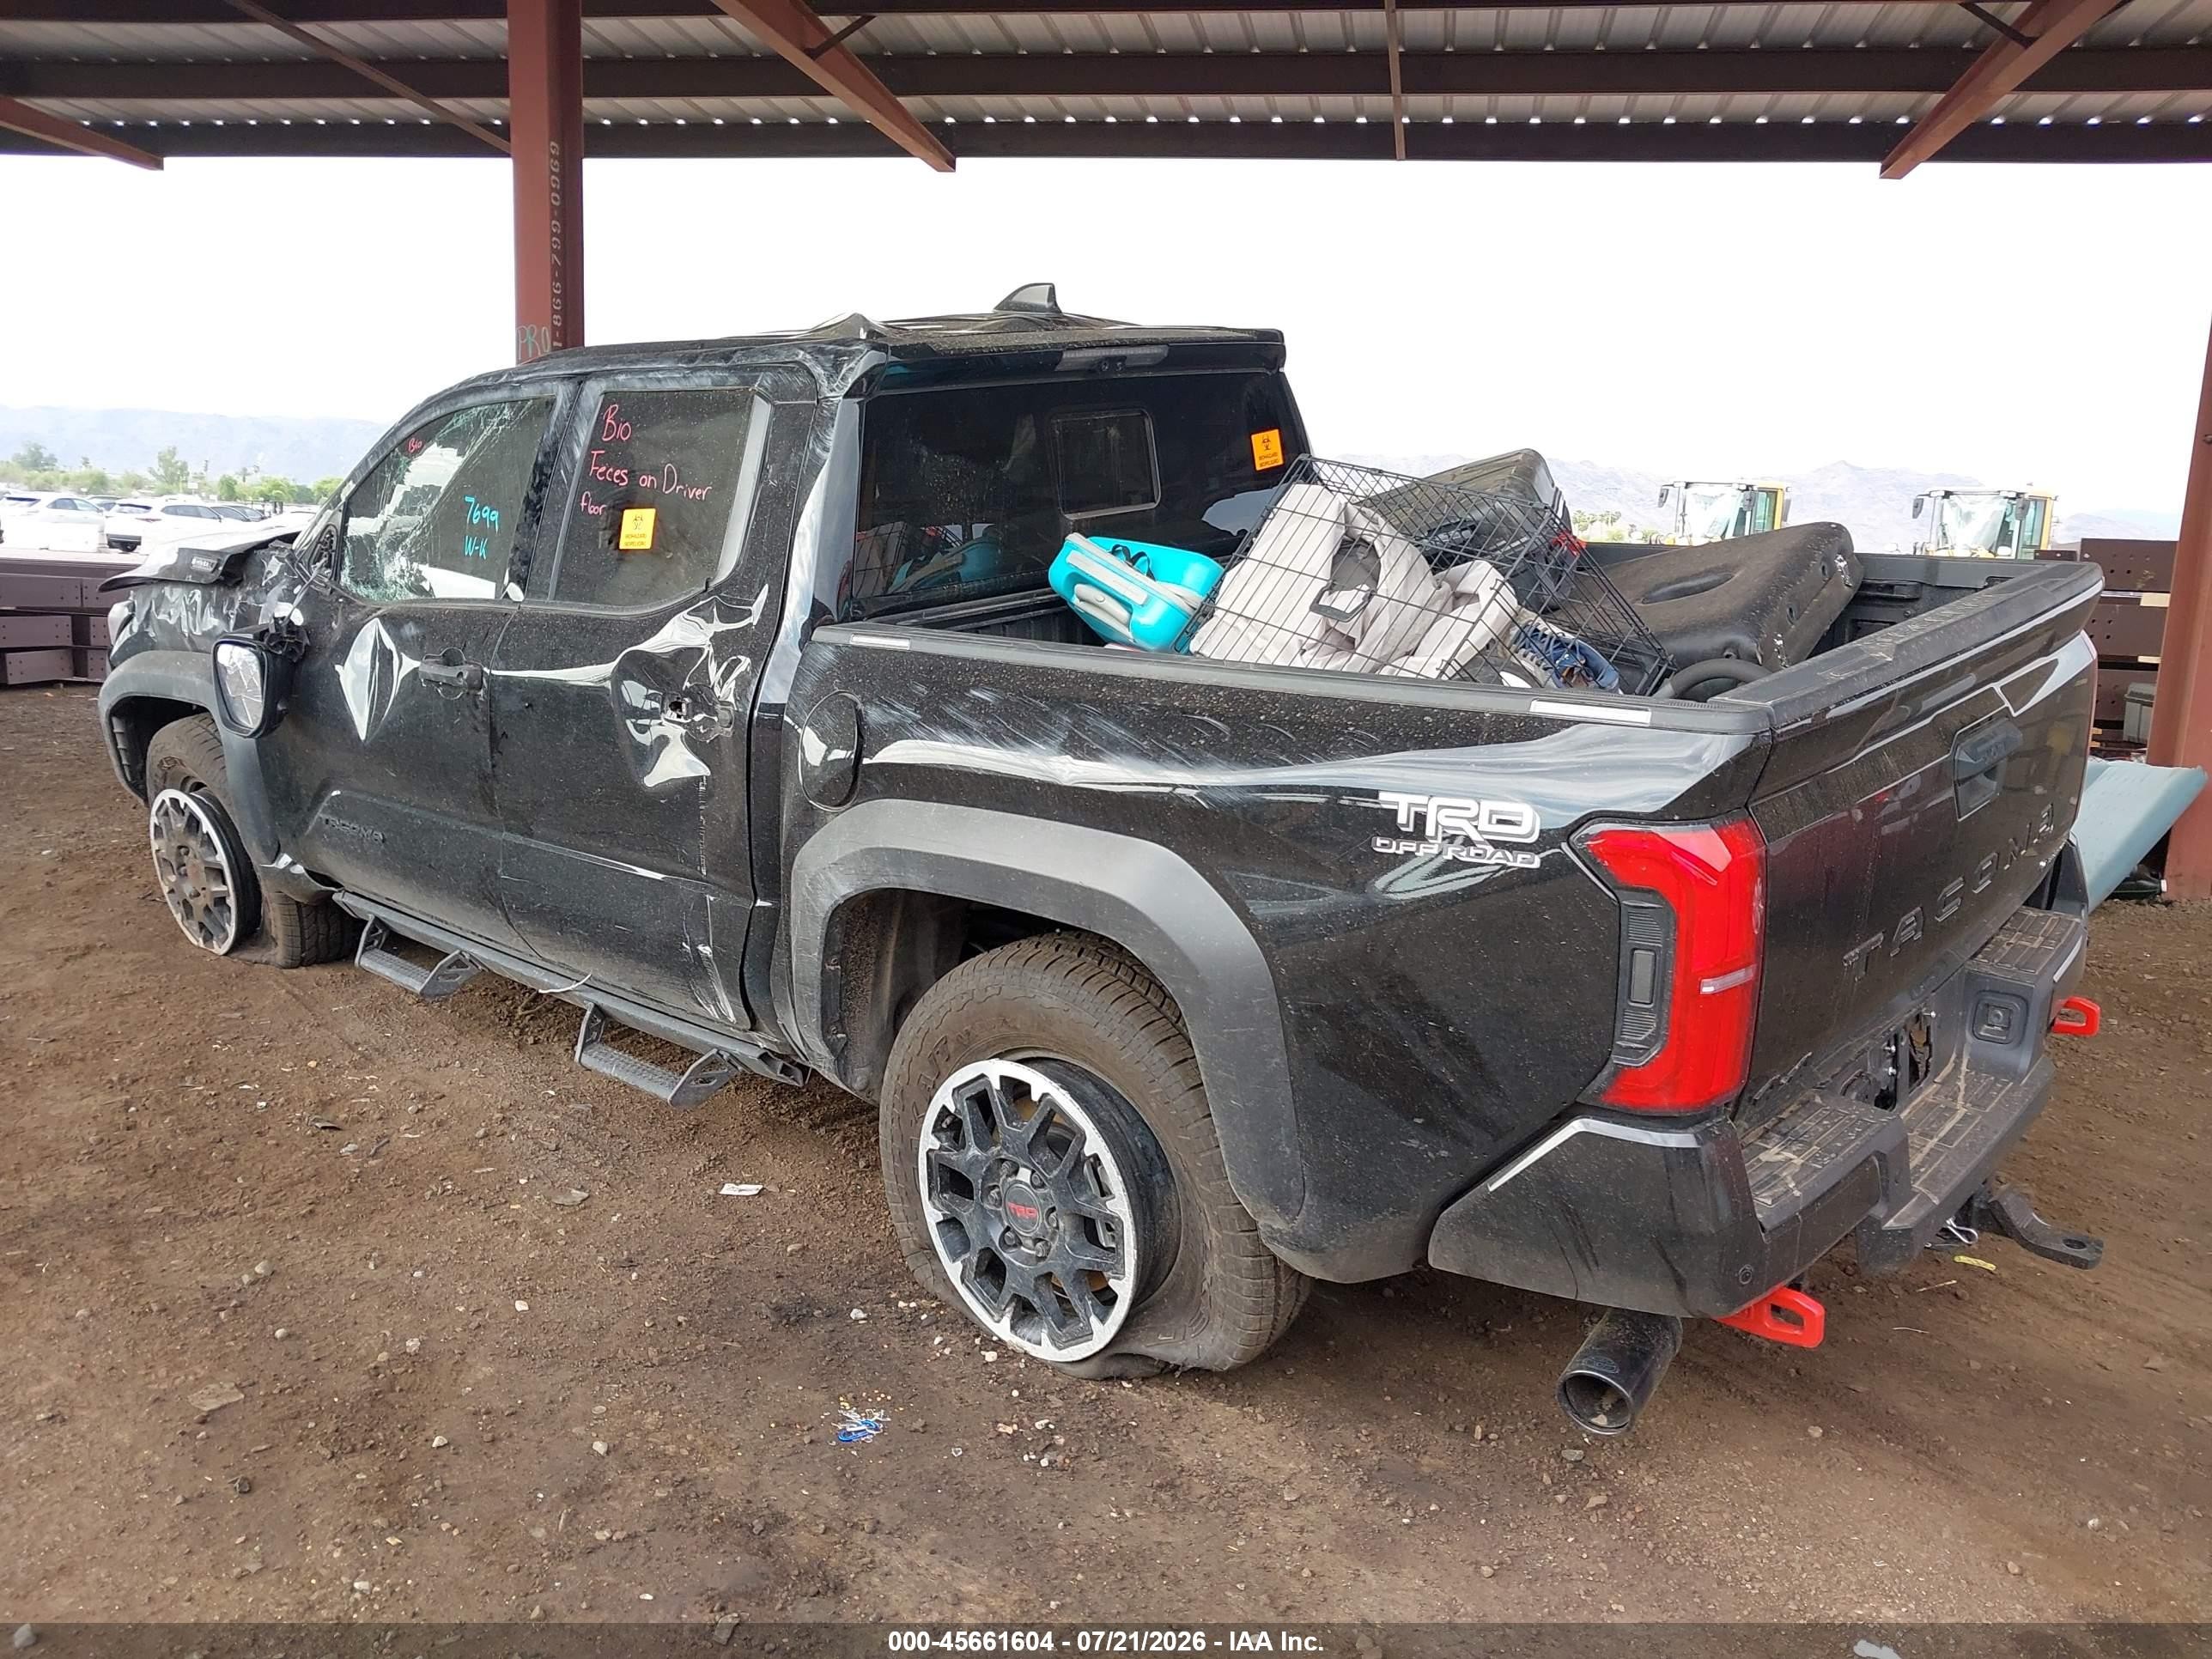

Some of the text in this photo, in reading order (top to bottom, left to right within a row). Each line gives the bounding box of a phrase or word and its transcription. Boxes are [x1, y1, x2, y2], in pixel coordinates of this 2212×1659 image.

[602, 404, 632, 441] Bio
[589, 451, 712, 501] Feces on Driver
[465, 495, 499, 534] 7699
[580, 491, 606, 515] floor
[1378, 791, 1540, 845] TRD
[1371, 836, 1541, 869] OFF ROAD
[1843, 803, 2054, 982] TACOMA
[1007, 1202, 1038, 1219] TRD
